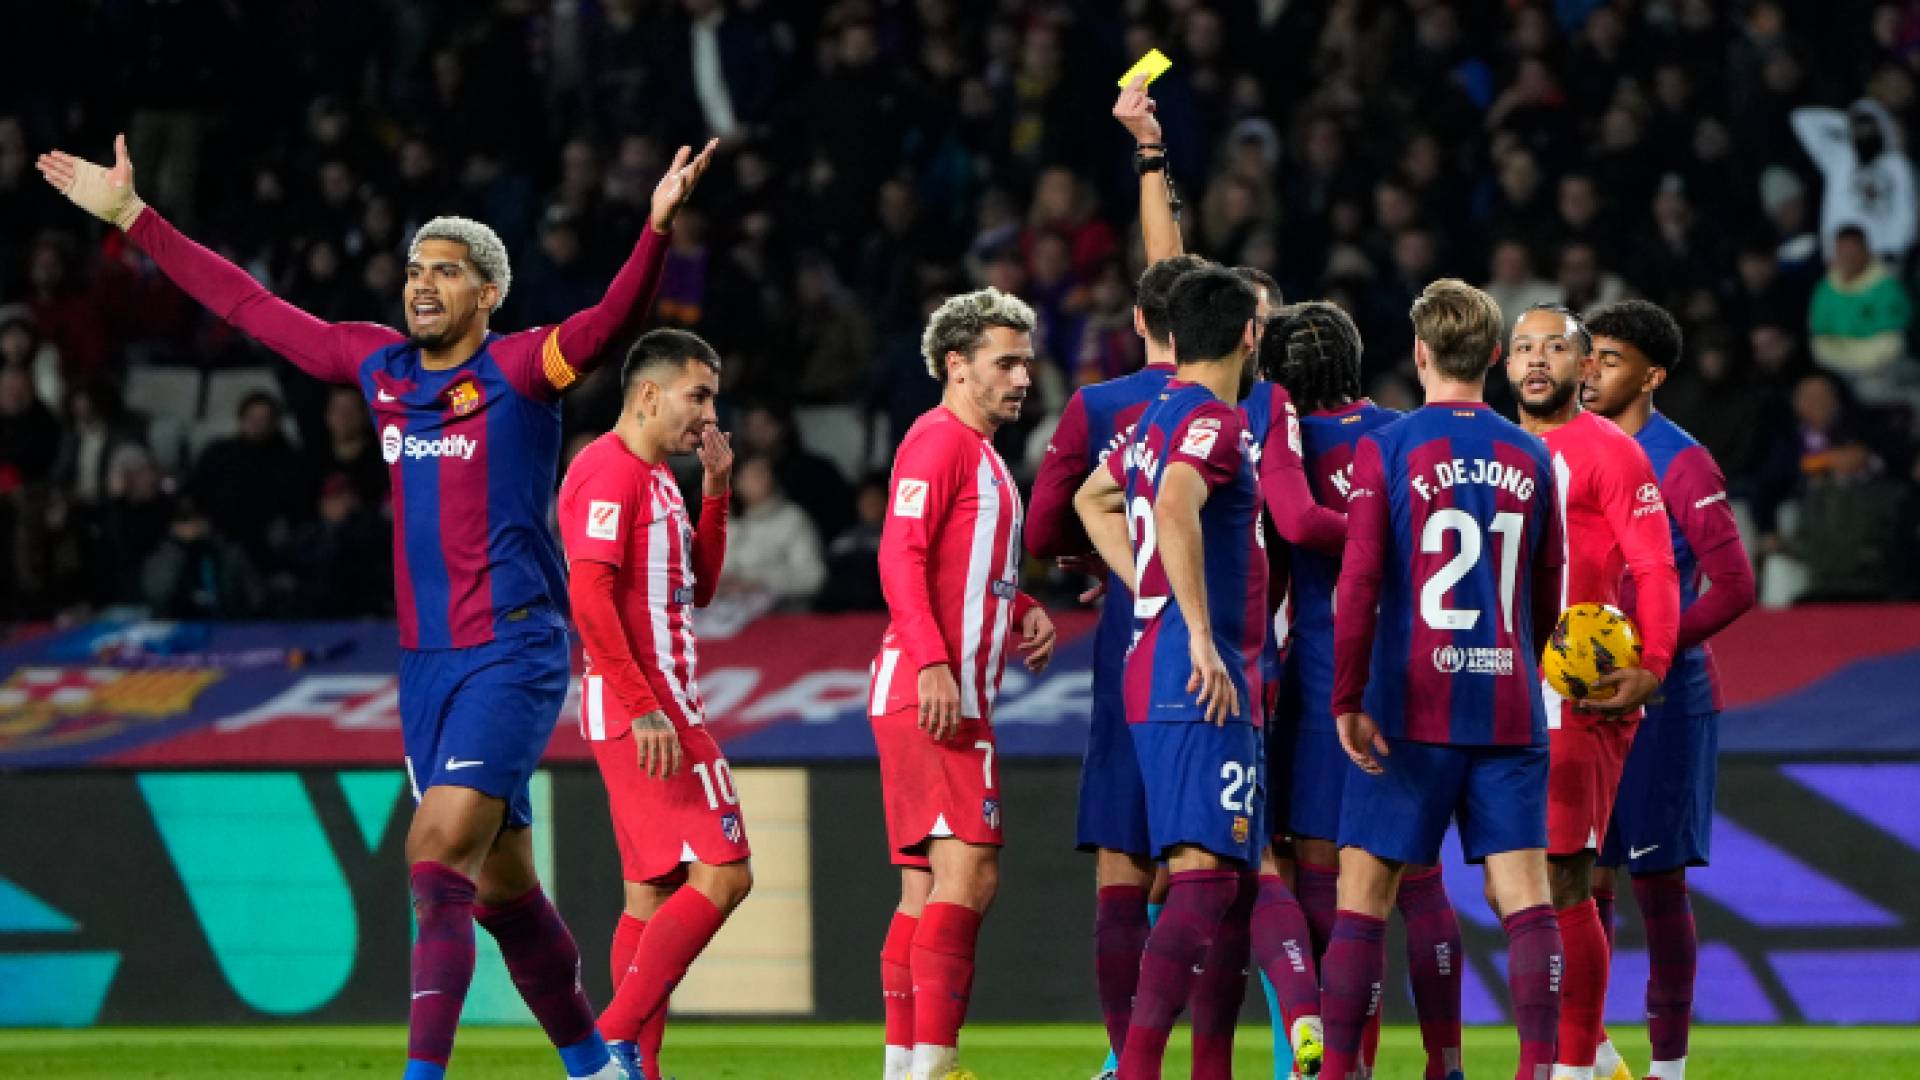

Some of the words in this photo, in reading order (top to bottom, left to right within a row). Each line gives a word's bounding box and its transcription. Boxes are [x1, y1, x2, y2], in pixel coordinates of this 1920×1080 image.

[404, 434, 478, 460] Spotify
[1411, 475, 1440, 501] F.
[1420, 508, 1524, 633] 21
[693, 758, 739, 810] 10
[974, 739, 995, 790] 7
[1220, 760, 1256, 817] 22
